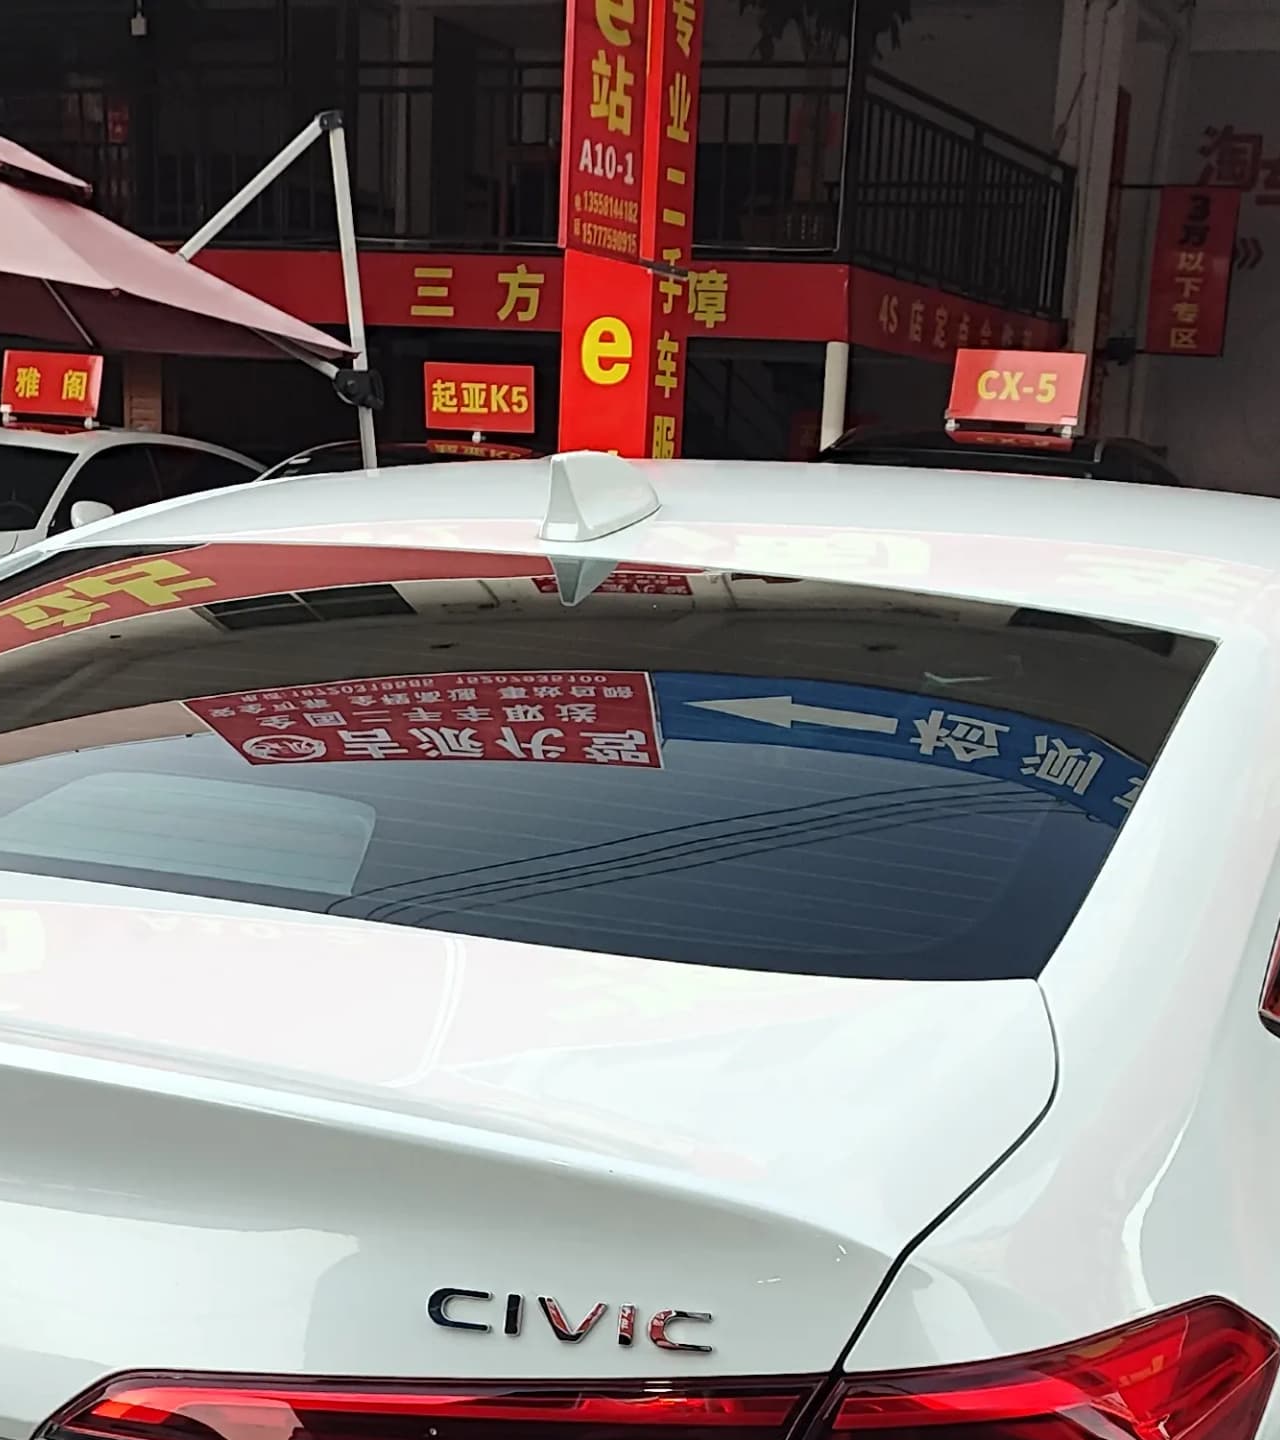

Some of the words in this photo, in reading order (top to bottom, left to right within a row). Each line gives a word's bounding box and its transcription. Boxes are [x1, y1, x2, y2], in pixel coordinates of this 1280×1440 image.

[579, 138, 635, 185] A10-1
[14, 366, 88, 402] 雅阁
[431, 379, 530, 414] 起亚K5
[976, 369, 1057, 404] CX-5
[426, 1287, 714, 1353] CIVIC
